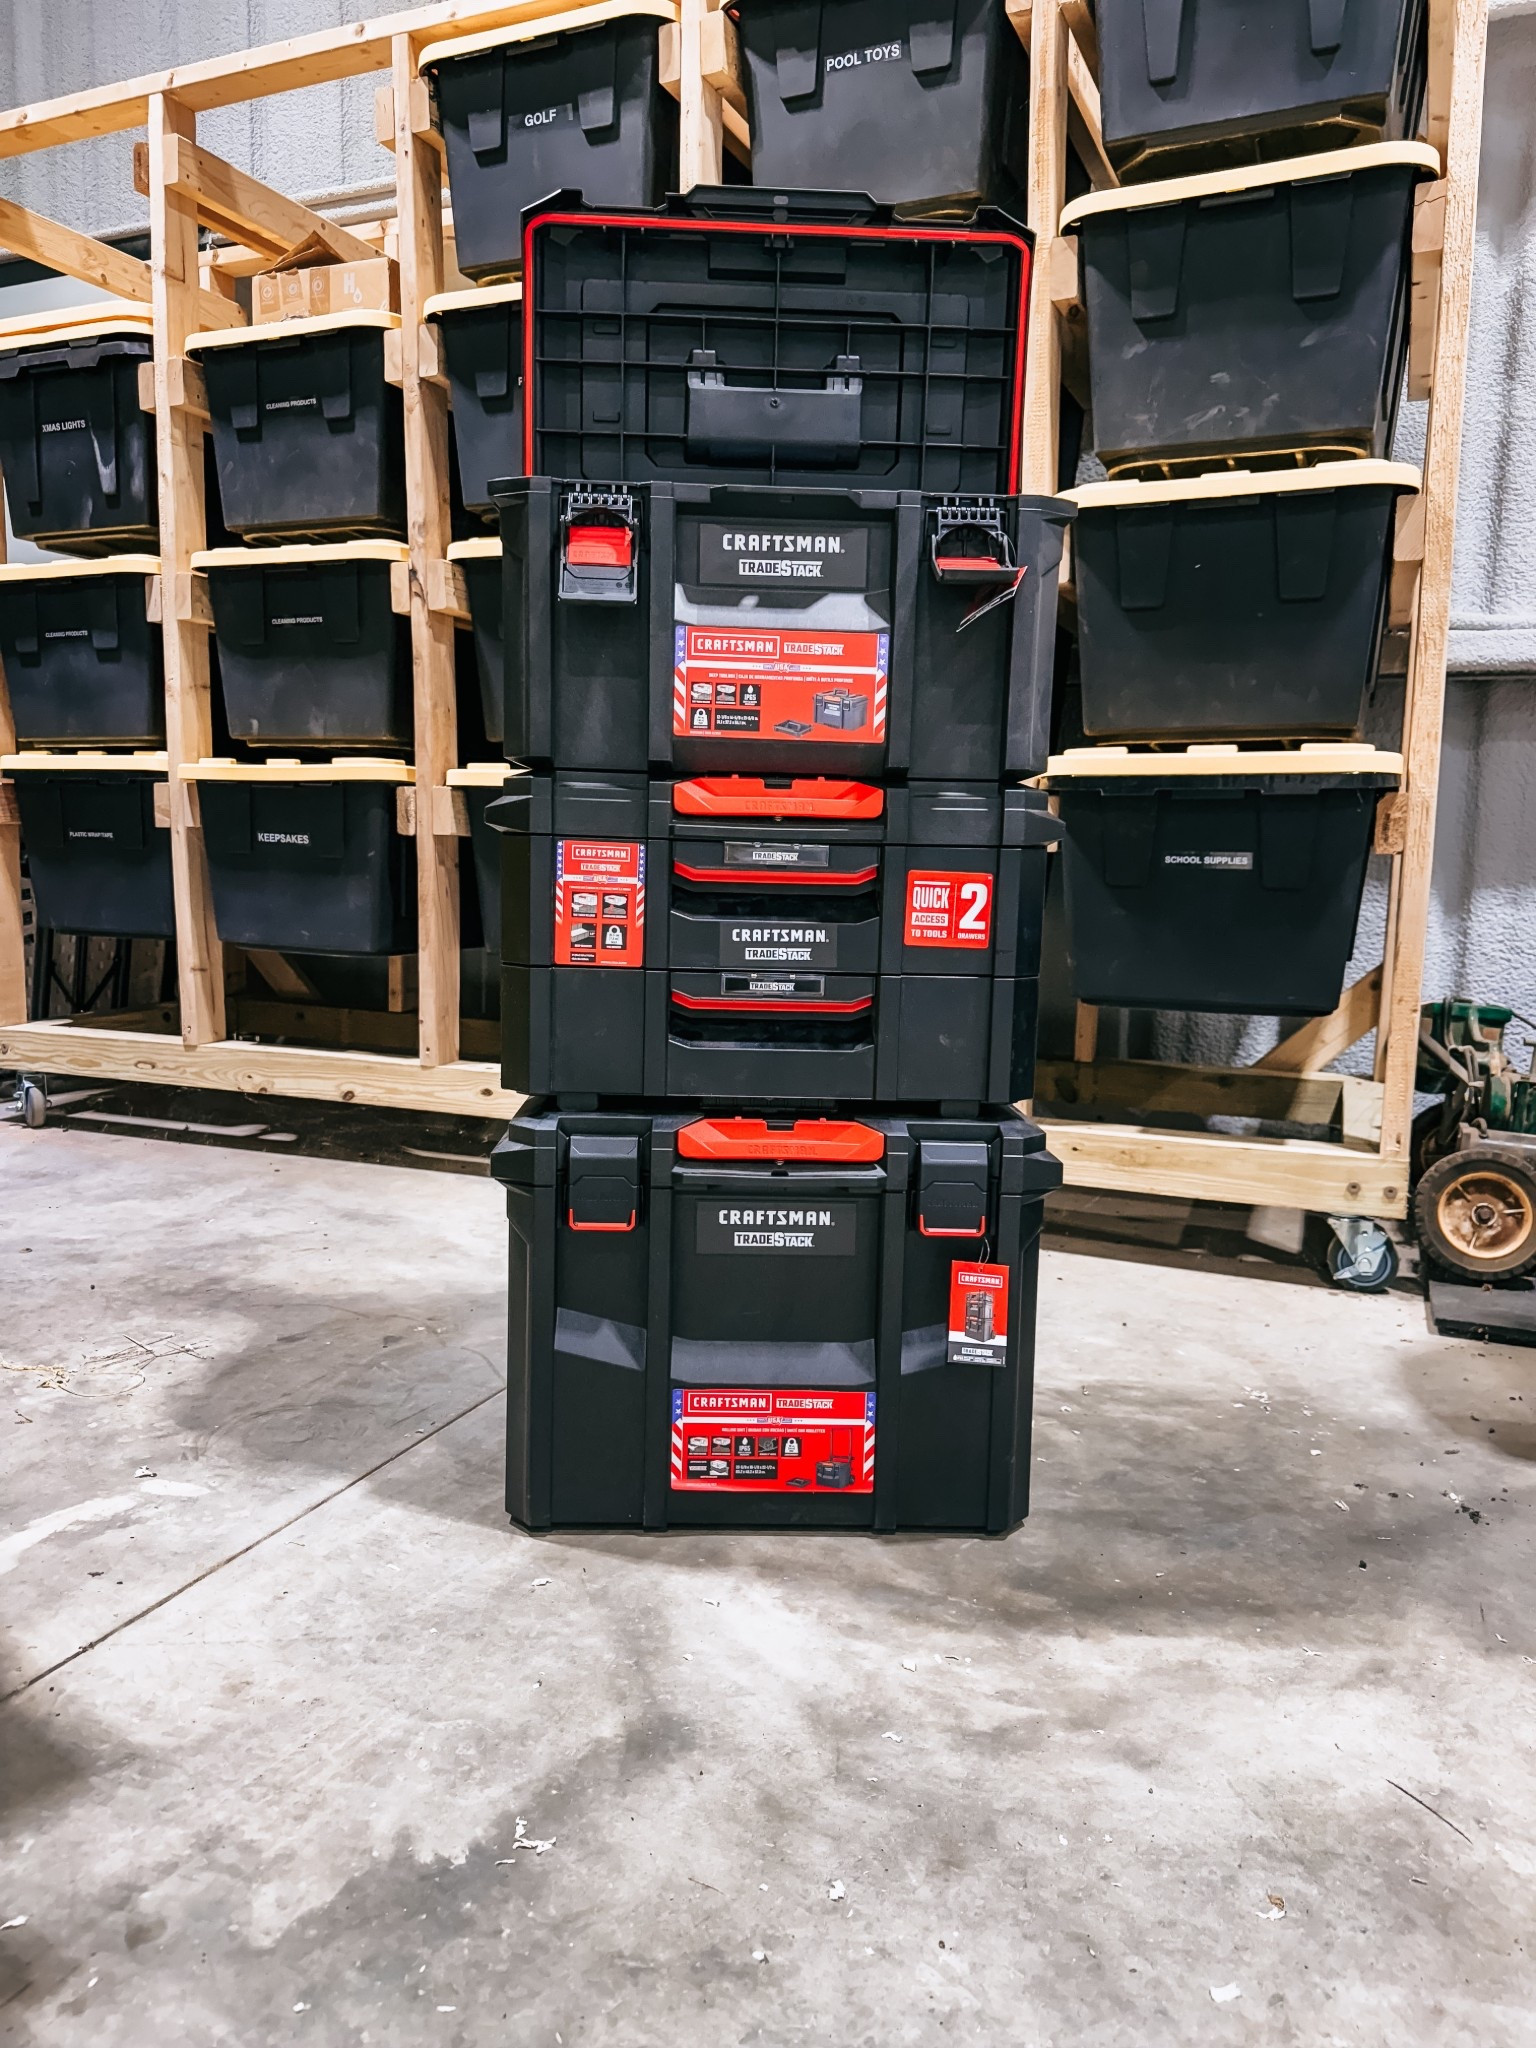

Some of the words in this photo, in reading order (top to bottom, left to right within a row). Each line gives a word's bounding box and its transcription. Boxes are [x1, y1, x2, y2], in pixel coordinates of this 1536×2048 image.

[826, 52, 862, 72] POOL
[864, 44, 900, 62] TOYS
[525, 109, 557, 126] GOLF
[266, 401, 290, 410] CLEANING
[290, 398, 316, 406] PRODUCTS
[42, 422, 61, 432] XMAS
[61, 419, 86, 430] LIGHTS
[722, 533, 842, 553] CRAFTSMAN
[696, 637, 776, 653] CRAFTSMAN
[257, 832, 310, 844] KEEPSAKES
[575, 848, 627, 858] CRAFTSMAN
[1164, 855, 1202, 864] SCHOOL
[1203, 856, 1248, 865] SUPPLIES
[913, 886, 950, 909] QUICK
[959, 882, 988, 930] 2
[914, 914, 946, 924] ACCESS
[732, 928, 826, 943] CRAFTSMAN
[911, 929, 921, 937] TO
[923, 929, 947, 938] TOOLS
[957, 932, 986, 940] DRAWERS
[718, 1209, 832, 1226] CRAFTSMAN
[961, 1275, 1000, 1285] CRAFTSMAN
[693, 1396, 767, 1408] CRAFTSMAN
